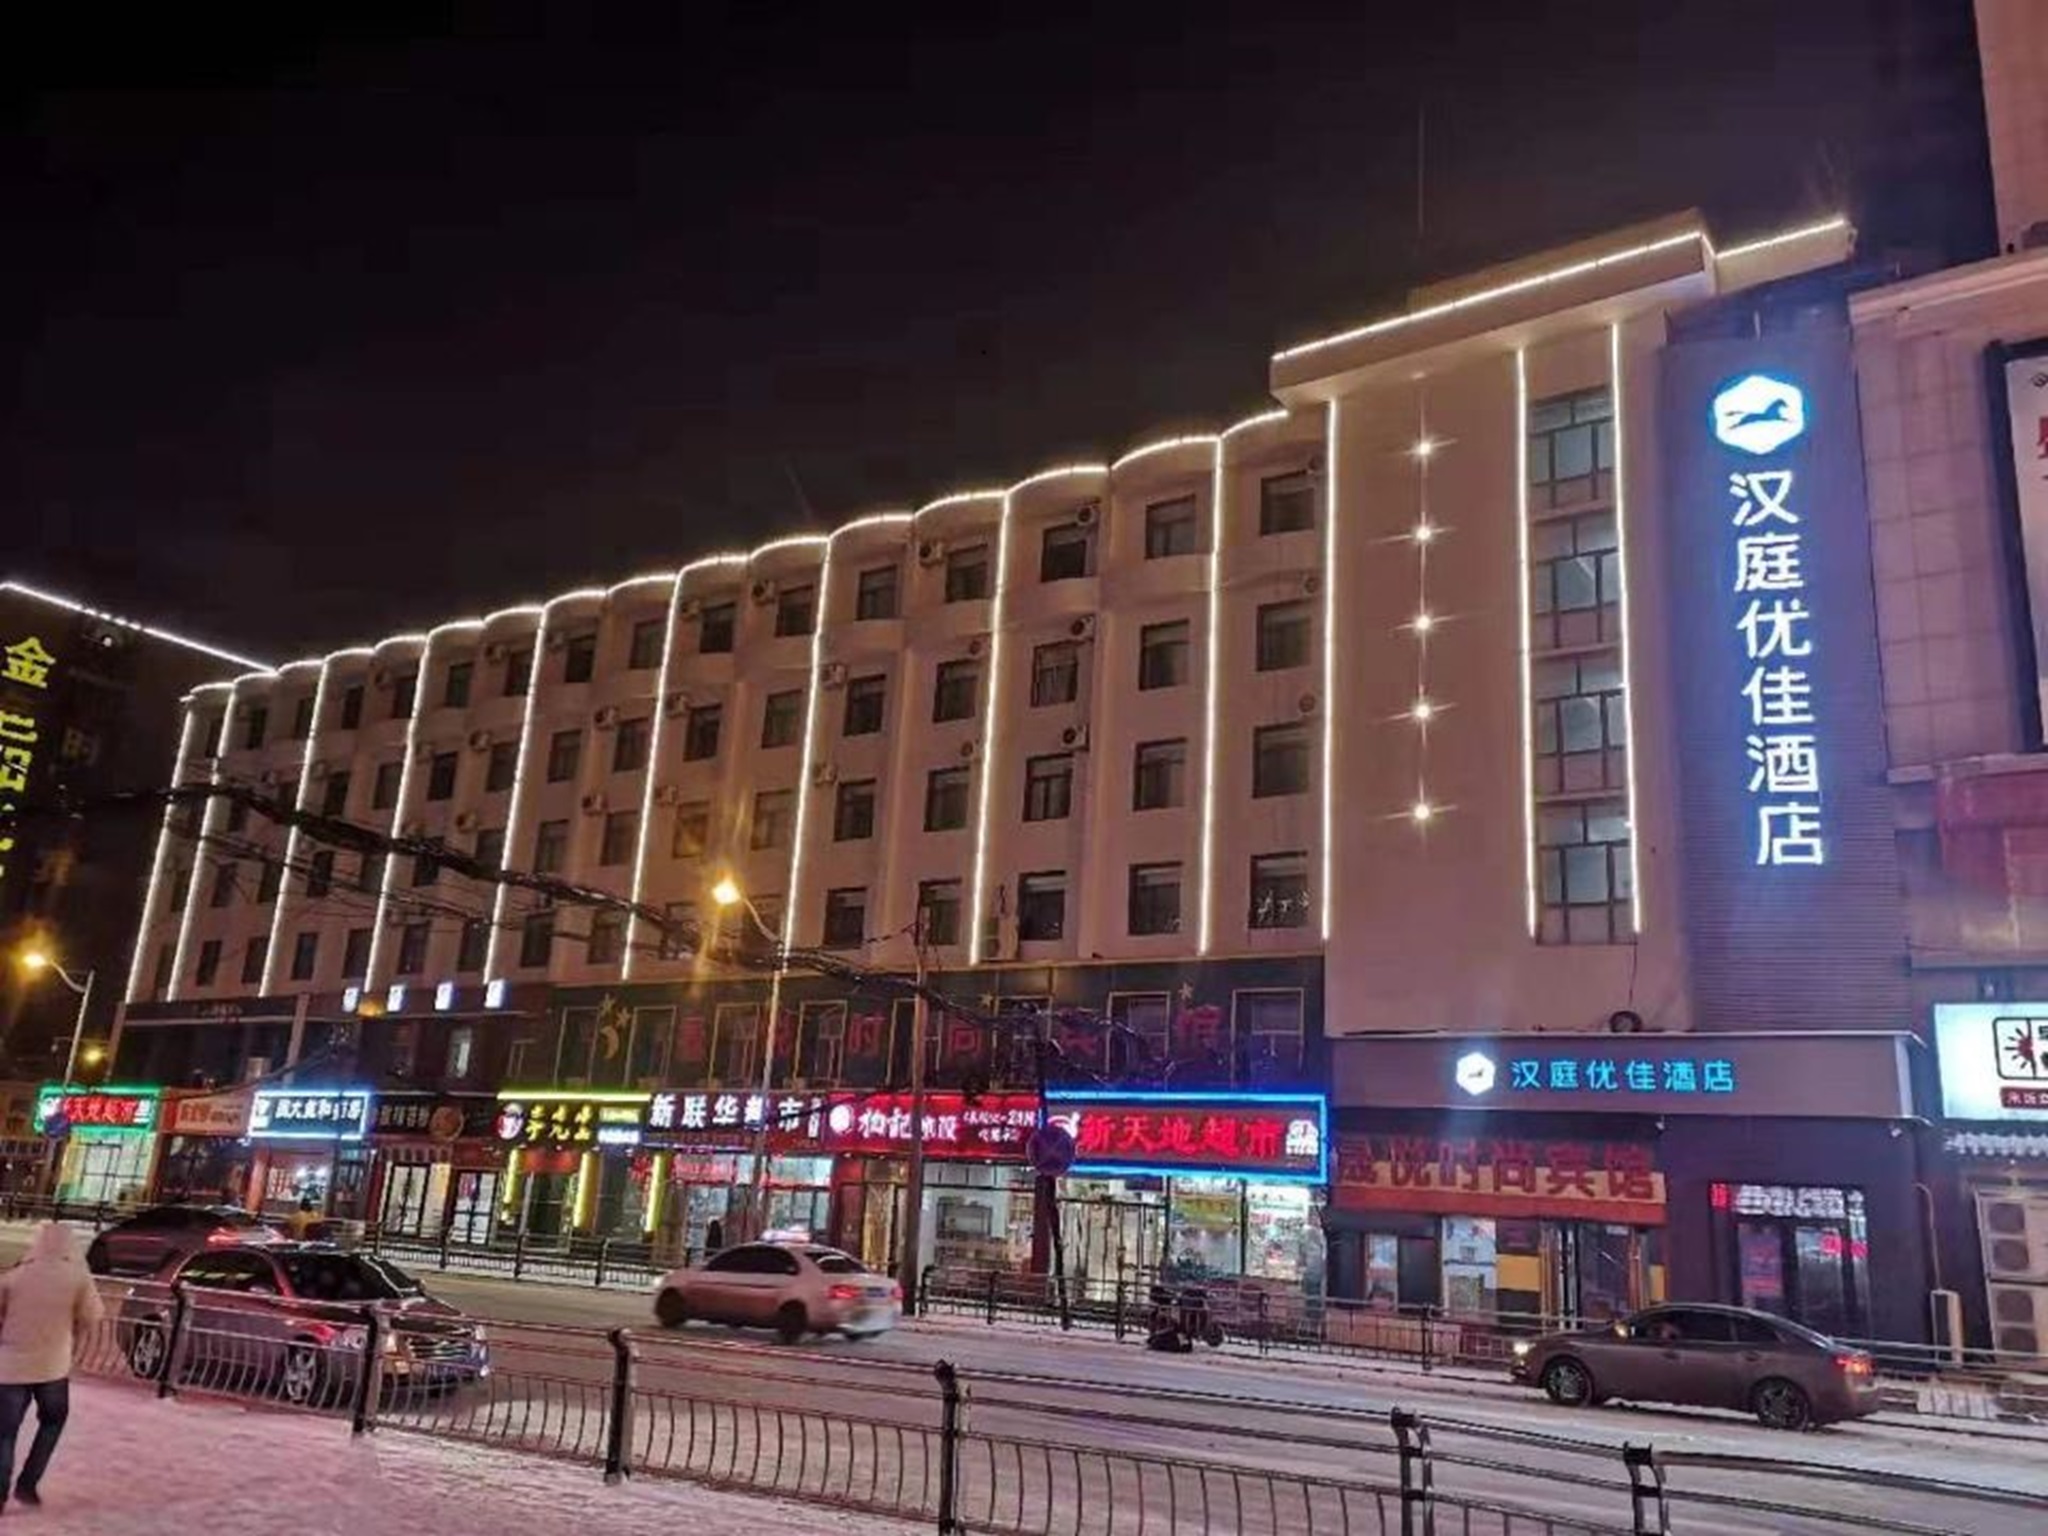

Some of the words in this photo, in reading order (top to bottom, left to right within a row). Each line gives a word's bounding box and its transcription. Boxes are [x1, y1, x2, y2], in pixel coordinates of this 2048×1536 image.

[1729, 471, 1824, 866] 汉庭优佳酒店
[1511, 1060, 1735, 1092] 汉庭优佳酒店
[650, 1094, 803, 1131] 新联华超市
[1078, 1112, 1282, 1158] 新天地超市
